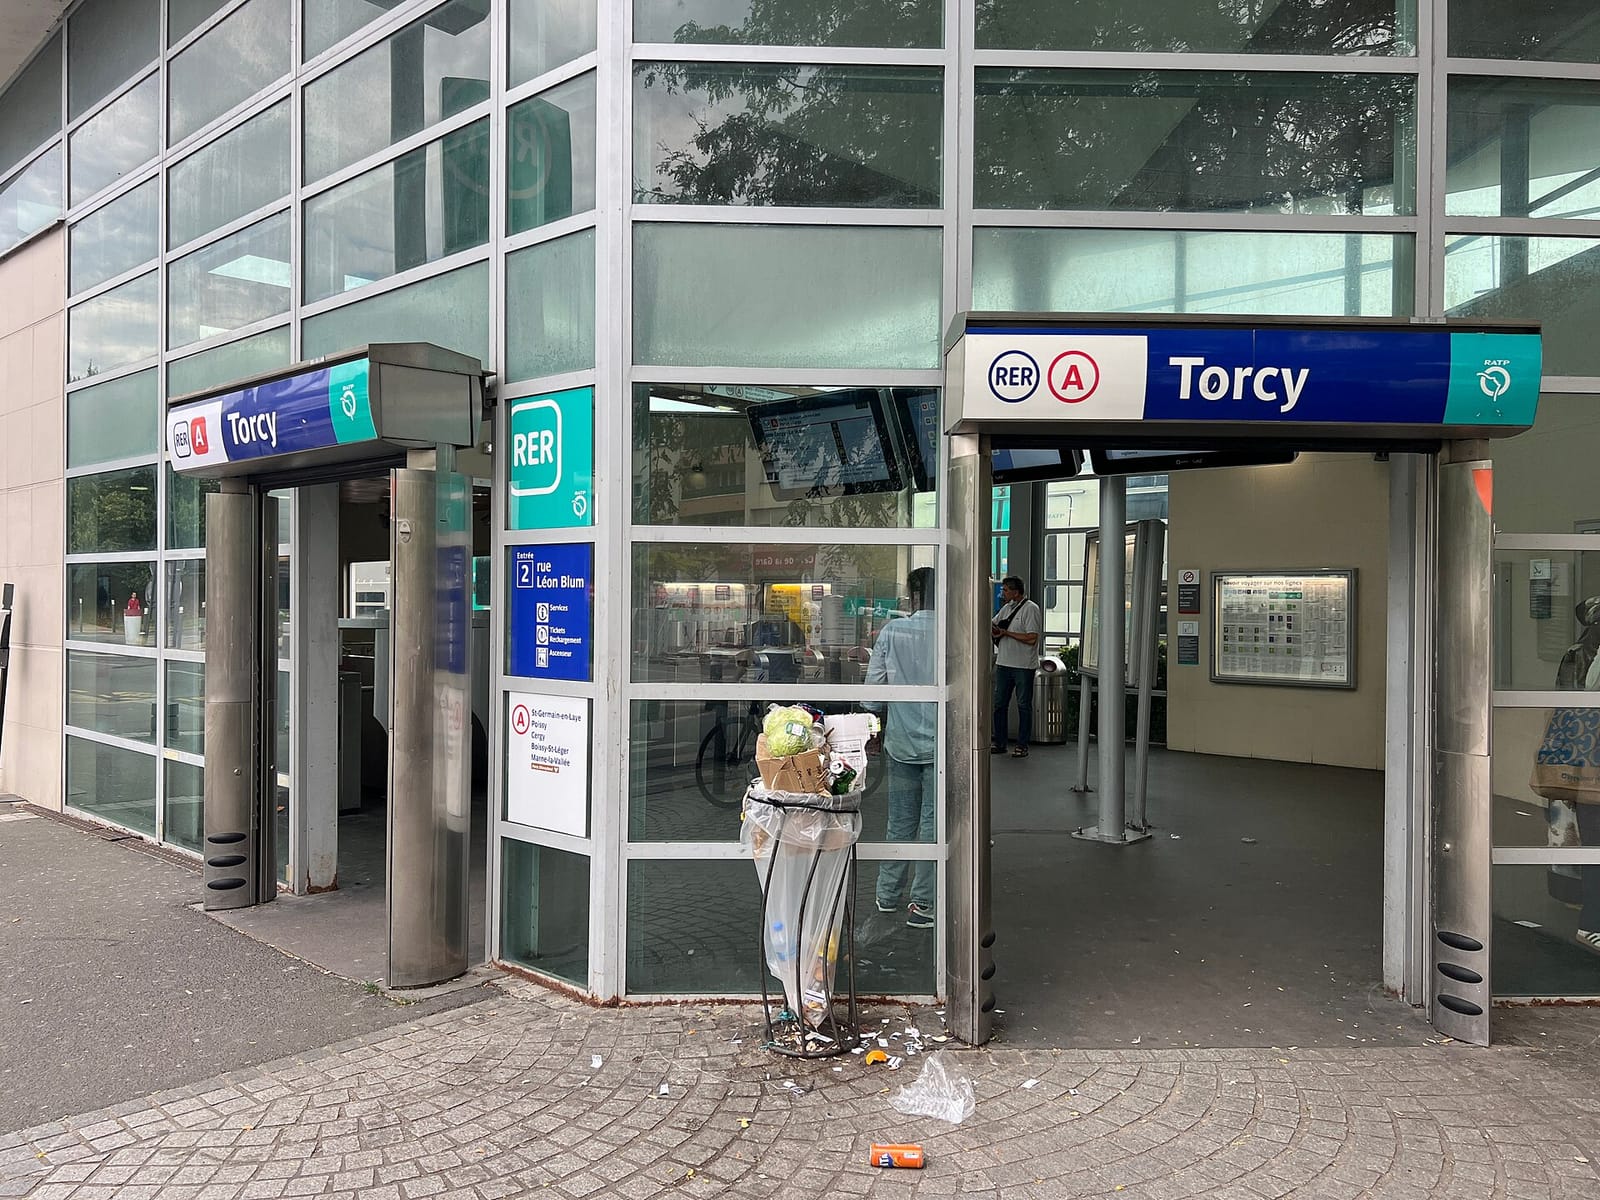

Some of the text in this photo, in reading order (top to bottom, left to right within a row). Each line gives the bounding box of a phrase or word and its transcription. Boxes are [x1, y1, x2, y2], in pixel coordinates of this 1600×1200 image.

[995, 356, 1310, 413] RER A Torcy
[176, 411, 278, 449] RER A Torcy
[513, 429, 554, 468] RER
[517, 552, 534, 560] Entrée
[521, 562, 552, 583] 2 rue
[536, 575, 584, 589] Léon Blum
[549, 604, 568, 612] Services
[549, 626, 566, 634] Tickets
[531, 709, 582, 722] St-Germain-en-Laye
[531, 720, 548, 730] Poissy
[531, 731, 546, 742] Cergy
[531, 742, 569, 756] Boissy-St-Léger
[531, 754, 570, 767] Marne-la-Vallée
